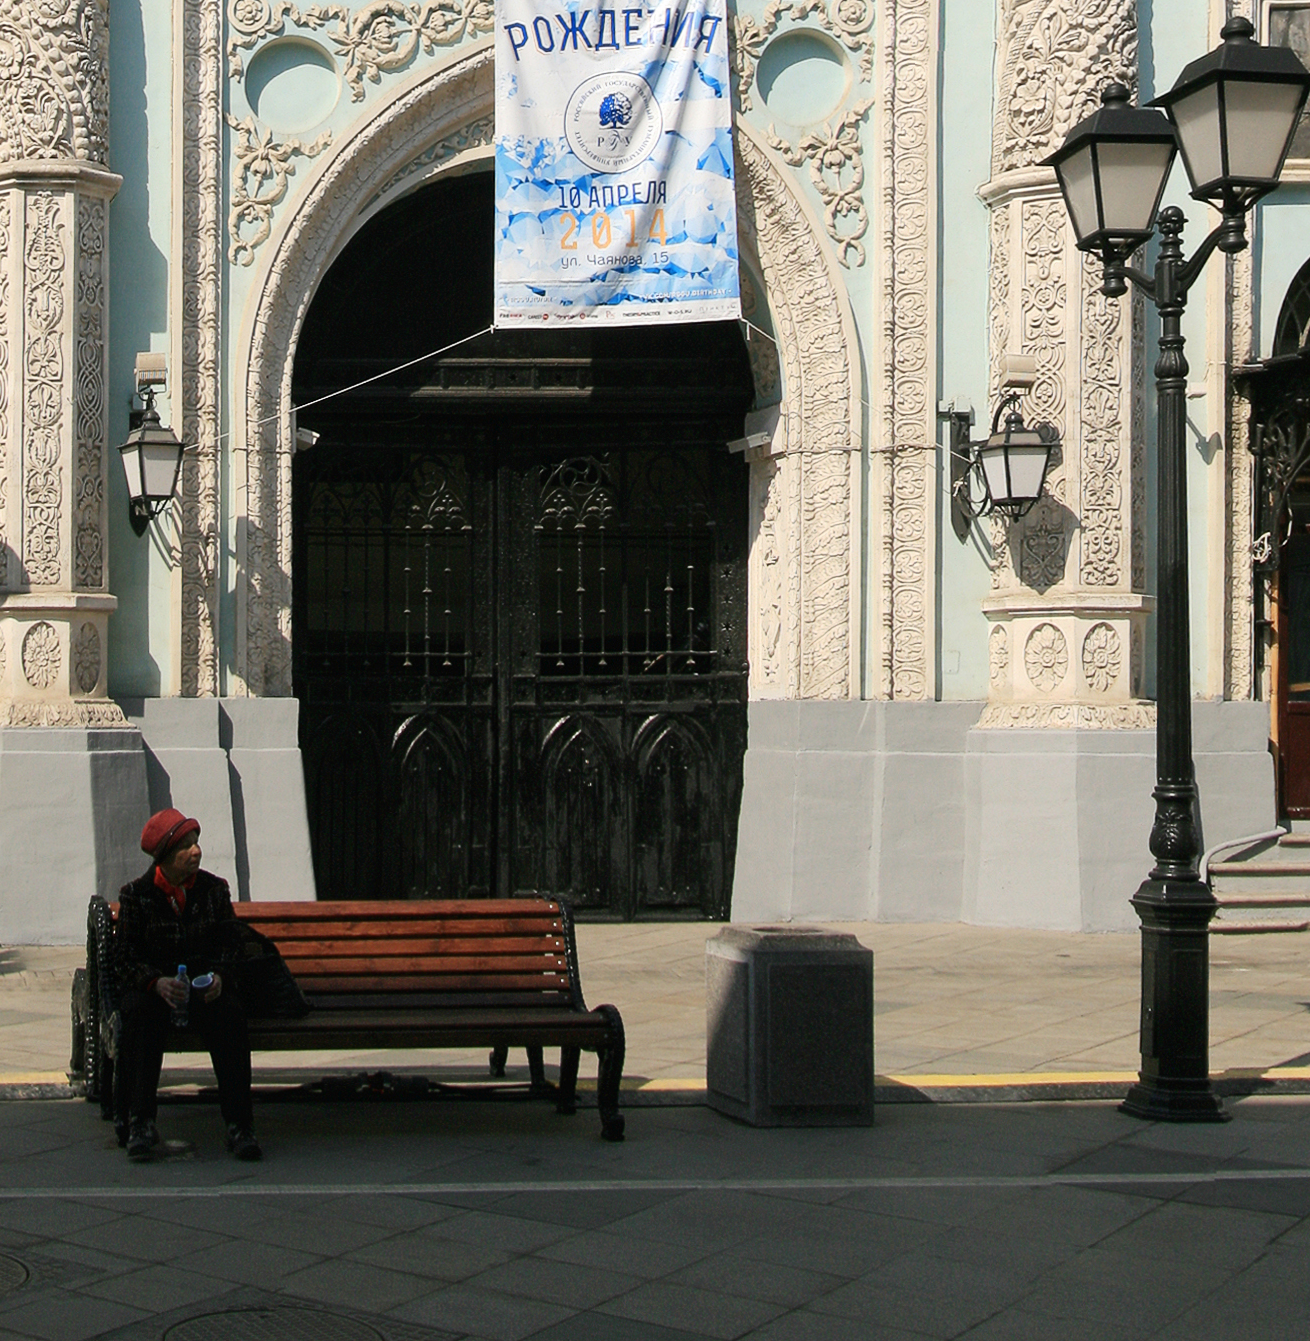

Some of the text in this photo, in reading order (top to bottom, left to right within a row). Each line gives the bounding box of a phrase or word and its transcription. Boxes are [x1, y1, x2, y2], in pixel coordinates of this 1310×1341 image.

[504, 8, 723, 61] РОЖДЕНИЯ
[559, 181, 667, 209] 10 АПРЕЛЯ
[559, 208, 668, 250] 2014
[561, 257, 581, 270] ул.
[653, 251, 669, 264] 15
